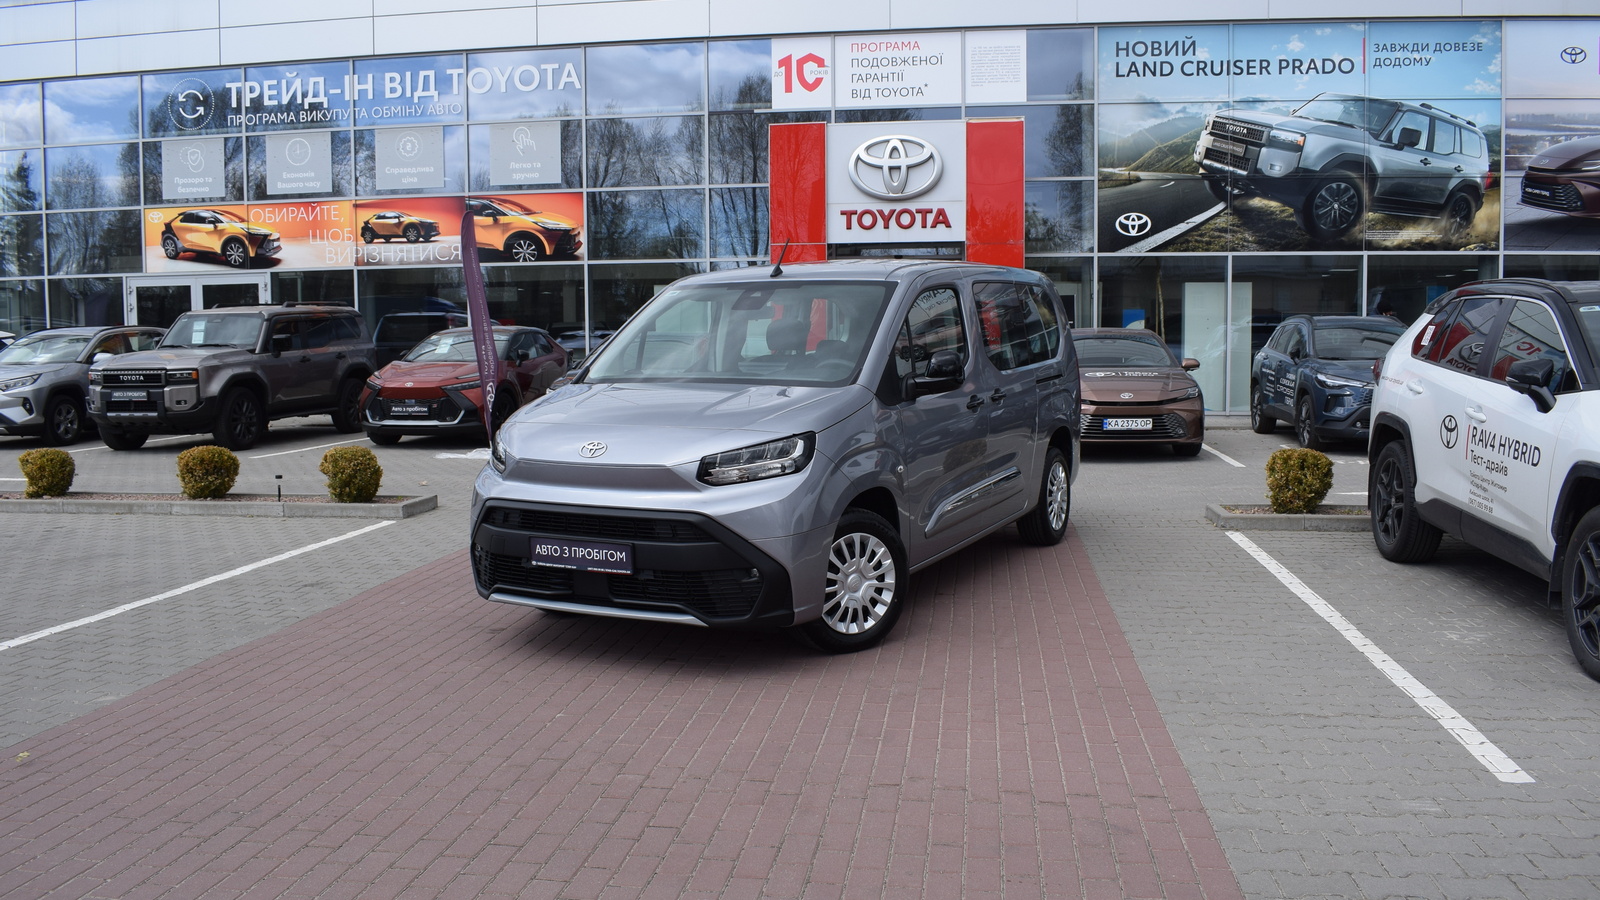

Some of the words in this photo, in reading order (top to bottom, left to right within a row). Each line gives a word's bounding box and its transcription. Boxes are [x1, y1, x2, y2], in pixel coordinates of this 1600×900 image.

[850, 41, 921, 53] ПРОГРАМА
[1115, 35, 1197, 58] НОВИЙ
[1373, 42, 1430, 54] ЗАВЖДИ
[1432, 42, 1483, 54] ДОВЕЗЕ
[851, 53, 944, 69] ПОДОВЖЕНОЇ
[1115, 60, 1175, 78] LAND
[1180, 58, 1272, 77] CRUISER
[1278, 57, 1356, 75] PRADO
[1372, 57, 1432, 69] ДОДОМУ
[851, 70, 905, 84] ГАРАНТІЇ
[225, 71, 374, 110] ТРЕЙД-ІН
[384, 69, 439, 103] ВІД
[446, 62, 582, 95] TOYOTA
[851, 88, 872, 100] ВІД
[227, 111, 297, 127] ПРОГРАМА
[300, 108, 350, 123] ВИКУПУ
[353, 107, 369, 119] ТА
[371, 105, 424, 119] ОБМІНУ
[427, 103, 462, 116] АВТО
[1225, 124, 1248, 134] TOYOTA
[385, 165, 435, 175] Справедлива
[509, 161, 532, 170] Легко
[174, 176, 205, 185] Прозоро
[282, 170, 315, 179] Економія
[511, 171, 540, 181] зручно
[177, 185, 210, 193] безпечно
[277, 180, 304, 189] Вашого
[304, 180, 321, 189] часу
[250, 203, 345, 223] ОБИРАЙТЕ,
[840, 207, 952, 231] TOYOTA
[308, 228, 354, 247] ЩОБ
[325, 243, 463, 265] ВИРІЗНЯТИСЯ
[1107, 420, 1120, 428] KA
[1120, 419, 1140, 428] 2375
[1471, 425, 1497, 452] RAV4
[1497, 434, 1542, 468] HYBRID
[1470, 449, 1509, 477] Тест-драйв
[535, 544, 560, 557] АВТО
[562, 546, 570, 557] З
[571, 547, 626, 562] ПРОБІГОМ
